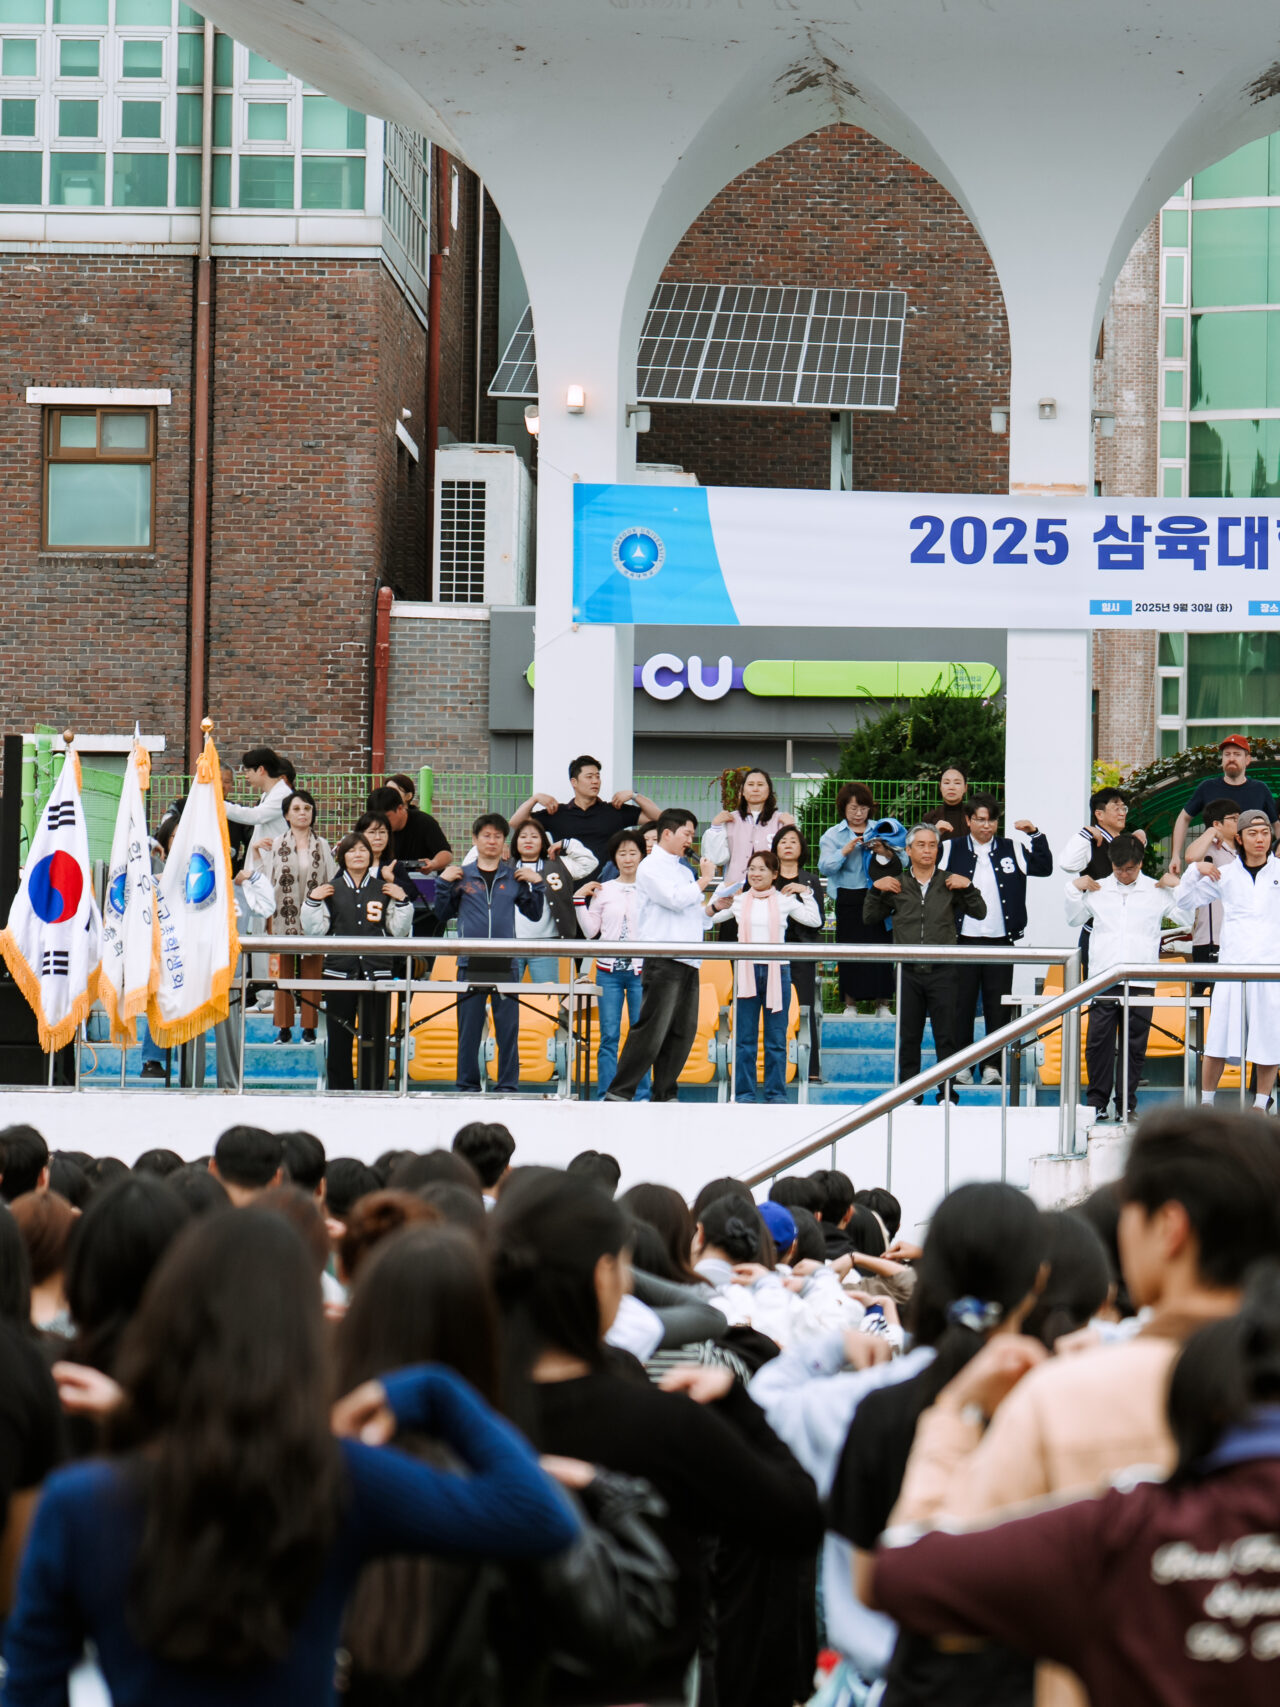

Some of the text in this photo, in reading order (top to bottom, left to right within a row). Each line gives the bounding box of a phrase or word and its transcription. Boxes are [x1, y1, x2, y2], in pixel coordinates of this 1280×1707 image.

[909, 515, 1069, 566] 2025
[1101, 602, 1120, 613] 일시
[1135, 602, 1171, 613] 2025년
[1172, 602, 1189, 613] 9월
[1190, 602, 1213, 613] 30일
[1216, 602, 1233, 613] (화)
[1260, 603, 1279, 613] 장소
[641, 653, 733, 700] CU
[546, 872, 563, 891] S
[366, 900, 383, 922] S
